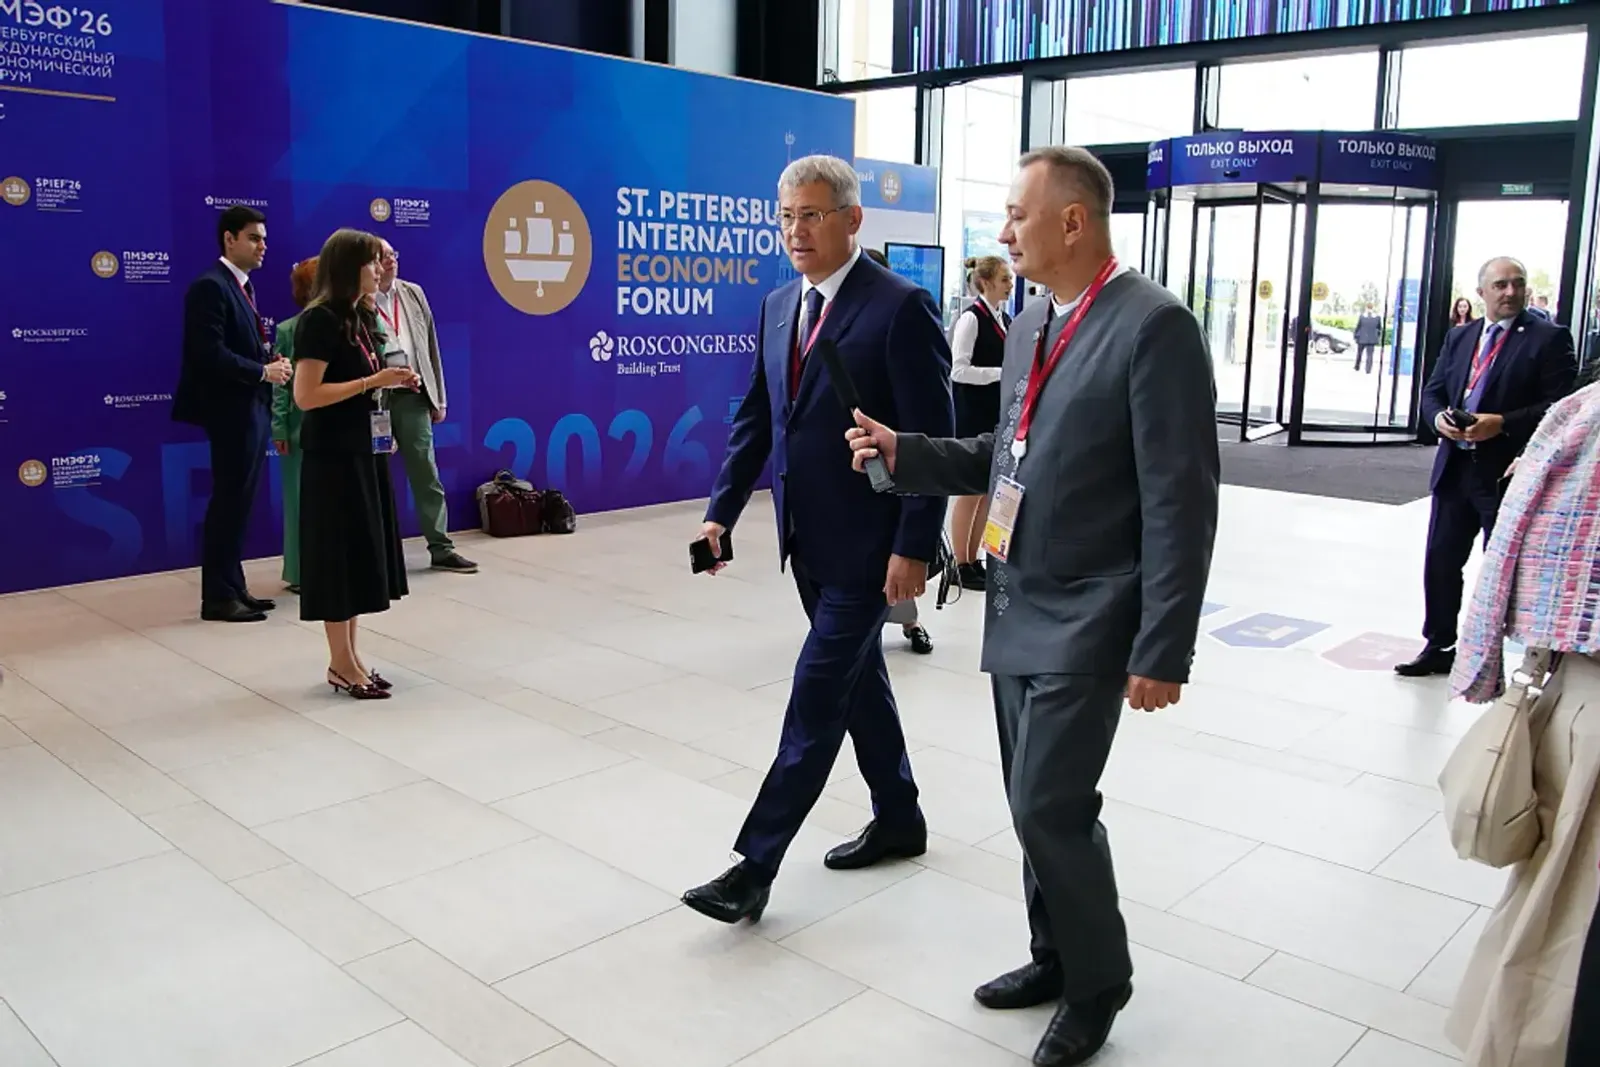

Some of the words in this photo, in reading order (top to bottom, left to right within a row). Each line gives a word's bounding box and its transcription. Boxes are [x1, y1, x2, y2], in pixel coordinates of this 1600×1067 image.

[1185, 142, 1234, 157] ТОЛЬКО
[1238, 139, 1294, 155] ВЫХОД
[1338, 139, 1395, 155] ТОЛЬКО
[1397, 143, 1436, 161] ВЫХОД
[1210, 159, 1230, 169] EXIT
[1232, 158, 1258, 168] ONLY
[1370, 159, 1390, 169] EXIT
[1392, 159, 1413, 171] ONLY
[616, 186, 654, 218] ST.
[617, 253, 759, 285] ECONOMIC
[617, 286, 713, 315] FORUM
[617, 334, 756, 357] ROSCONGRESS
[617, 361, 657, 377] Building
[657, 361, 681, 374] Trust
